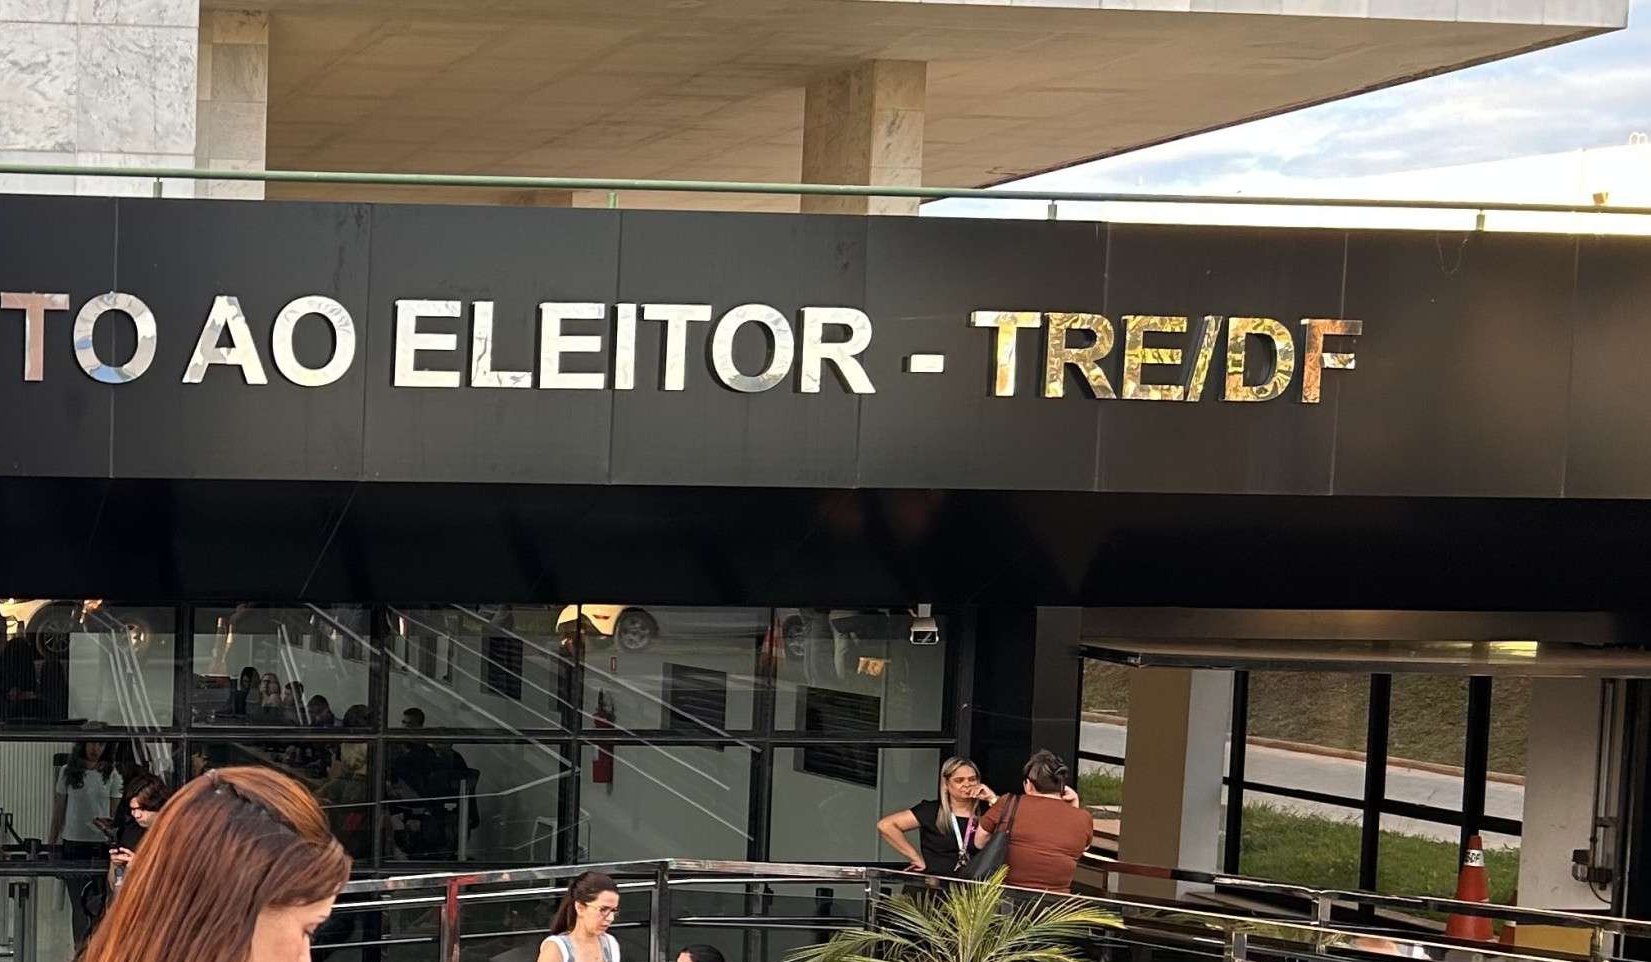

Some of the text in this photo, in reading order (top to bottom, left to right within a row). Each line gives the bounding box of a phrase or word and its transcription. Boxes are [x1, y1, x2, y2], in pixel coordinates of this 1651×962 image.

[181, 294, 357, 387] AO
[391, 298, 876, 395] ELEITOR
[905, 353, 945, 374] -
[969, 309, 1363, 404] TRE/DF
